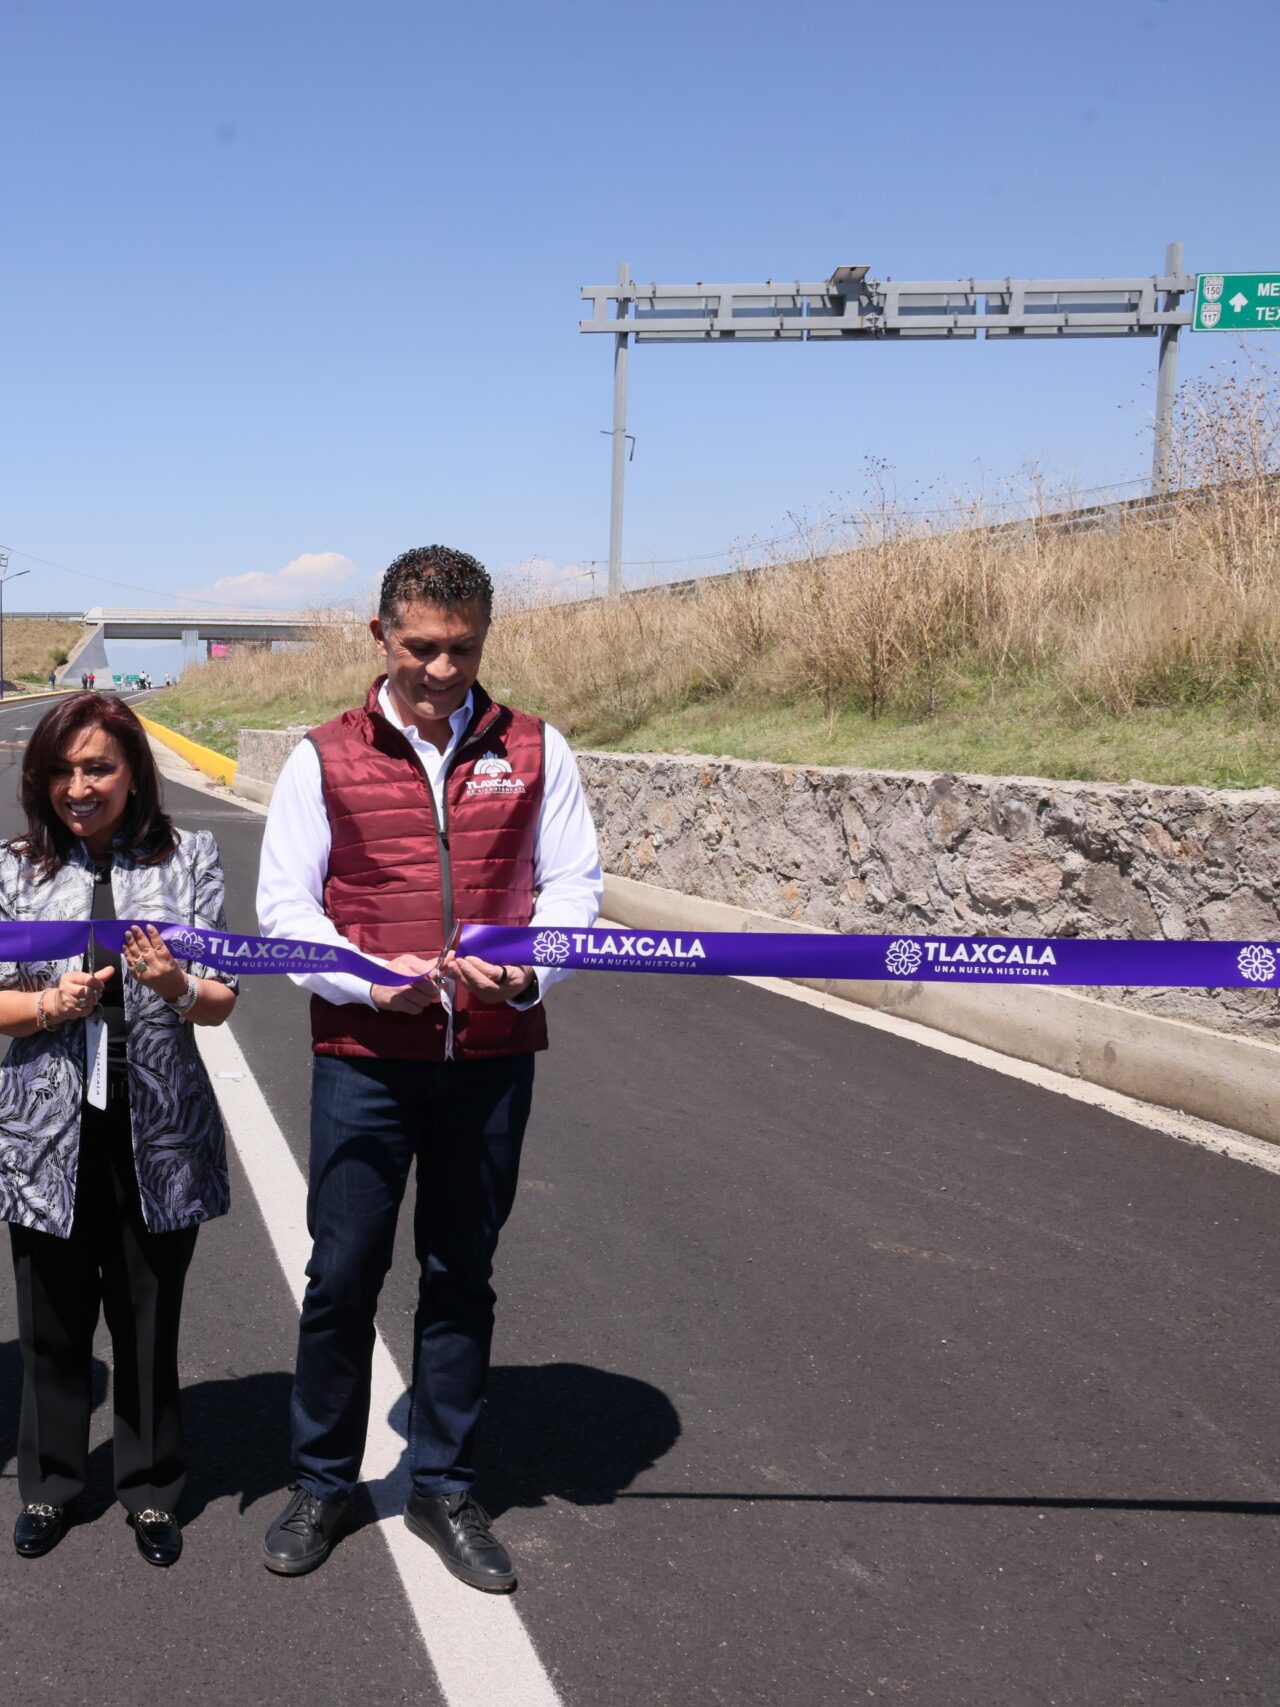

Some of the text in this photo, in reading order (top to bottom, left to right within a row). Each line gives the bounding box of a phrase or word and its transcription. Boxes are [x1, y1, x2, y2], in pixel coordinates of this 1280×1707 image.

[465, 779, 525, 789] TLAXCALA
[208, 936, 338, 962] TLAXCALA
[572, 933, 706, 959] TLAXCALA
[924, 942, 1057, 965] TLAXCALA
[218, 959, 329, 969] UNA NUEVA HISTORIA
[583, 957, 697, 968] UNA NUEVA HISTORIA
[934, 965, 1049, 976] UNA NUEVA HISTORIA
